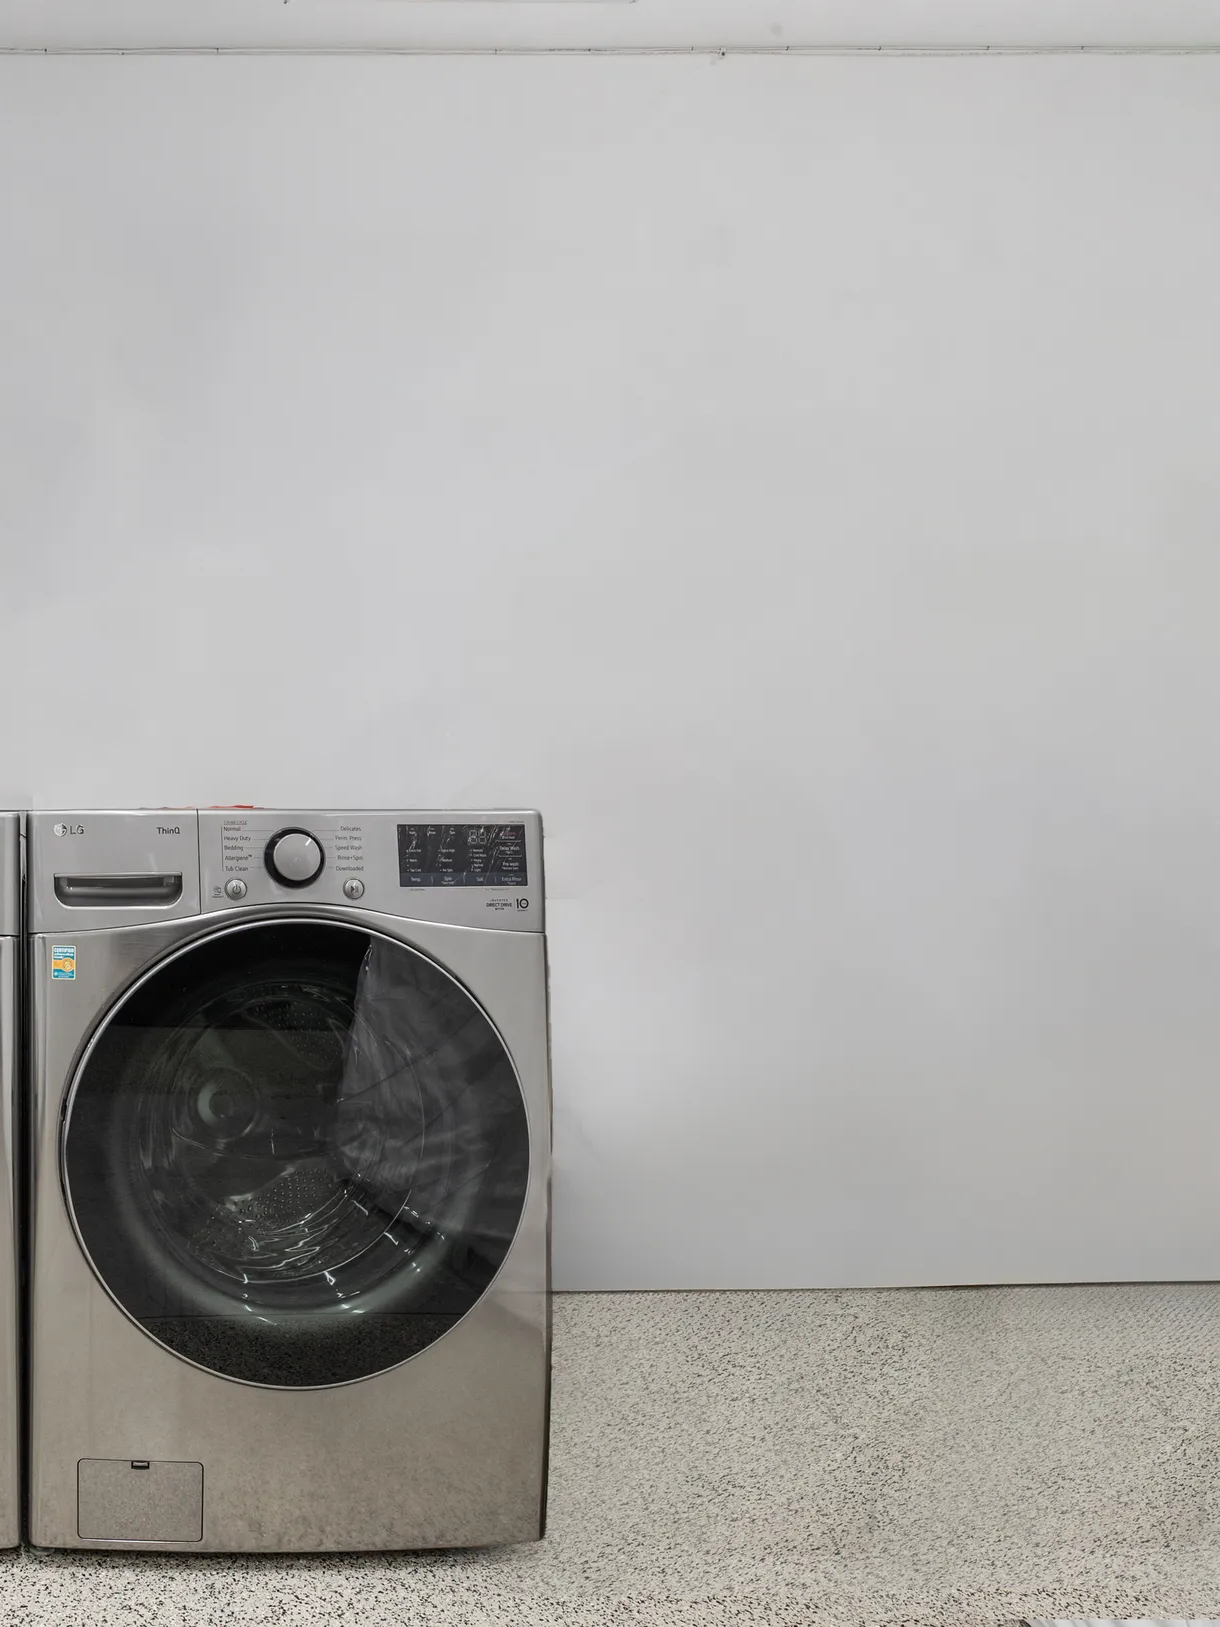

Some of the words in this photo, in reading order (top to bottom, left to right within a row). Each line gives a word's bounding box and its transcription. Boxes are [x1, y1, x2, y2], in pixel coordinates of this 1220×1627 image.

[70, 825, 84, 834] LG
[156, 826, 180, 834] ThinQ
[516, 898, 529, 909] 10
